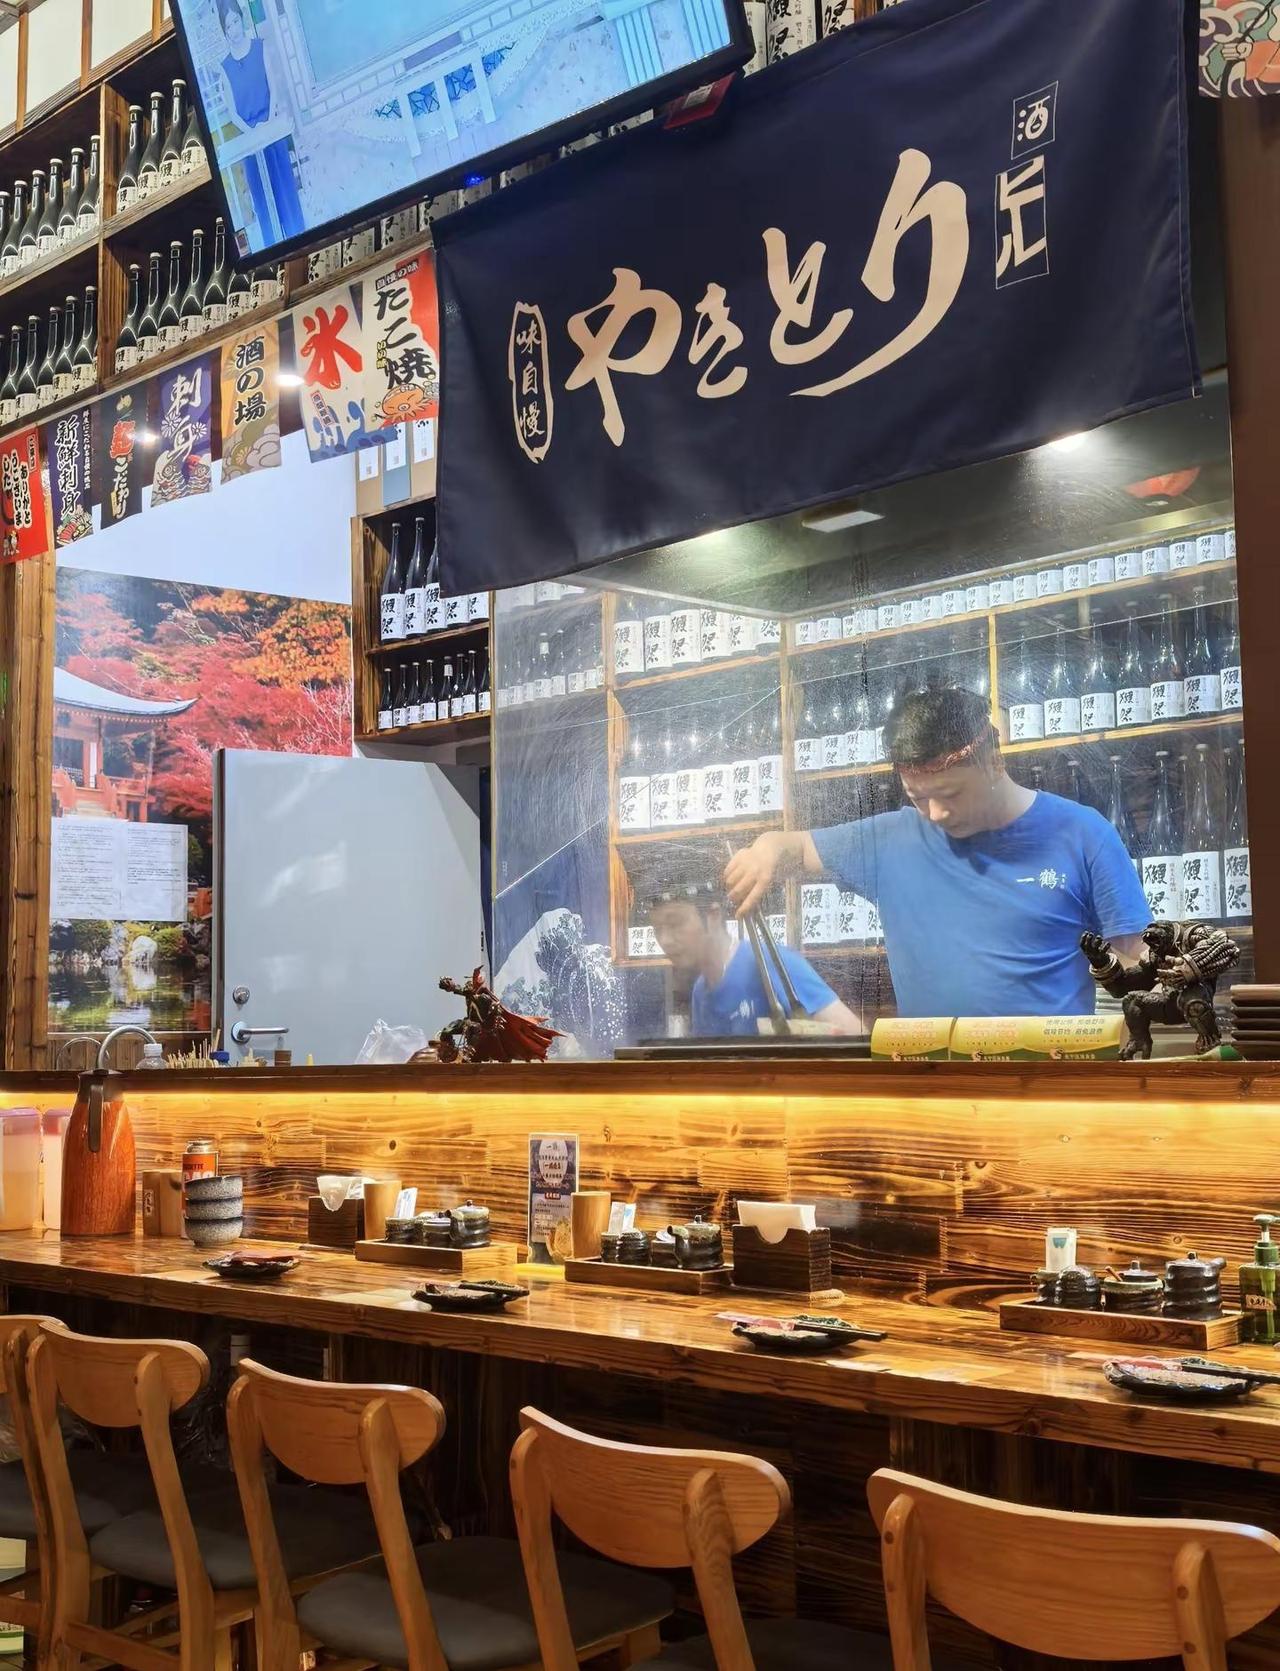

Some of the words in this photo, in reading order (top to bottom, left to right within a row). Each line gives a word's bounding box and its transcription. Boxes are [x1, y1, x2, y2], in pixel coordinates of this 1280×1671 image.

[1016, 95, 1051, 142] 酒
[374, 286, 436, 389] たこ焼
[565, 147, 970, 447] やきとり
[234, 334, 267, 427] 酒の場
[301, 304, 363, 390] 氷
[516, 319, 545, 440] 味自慢
[167, 366, 202, 462] 刺身
